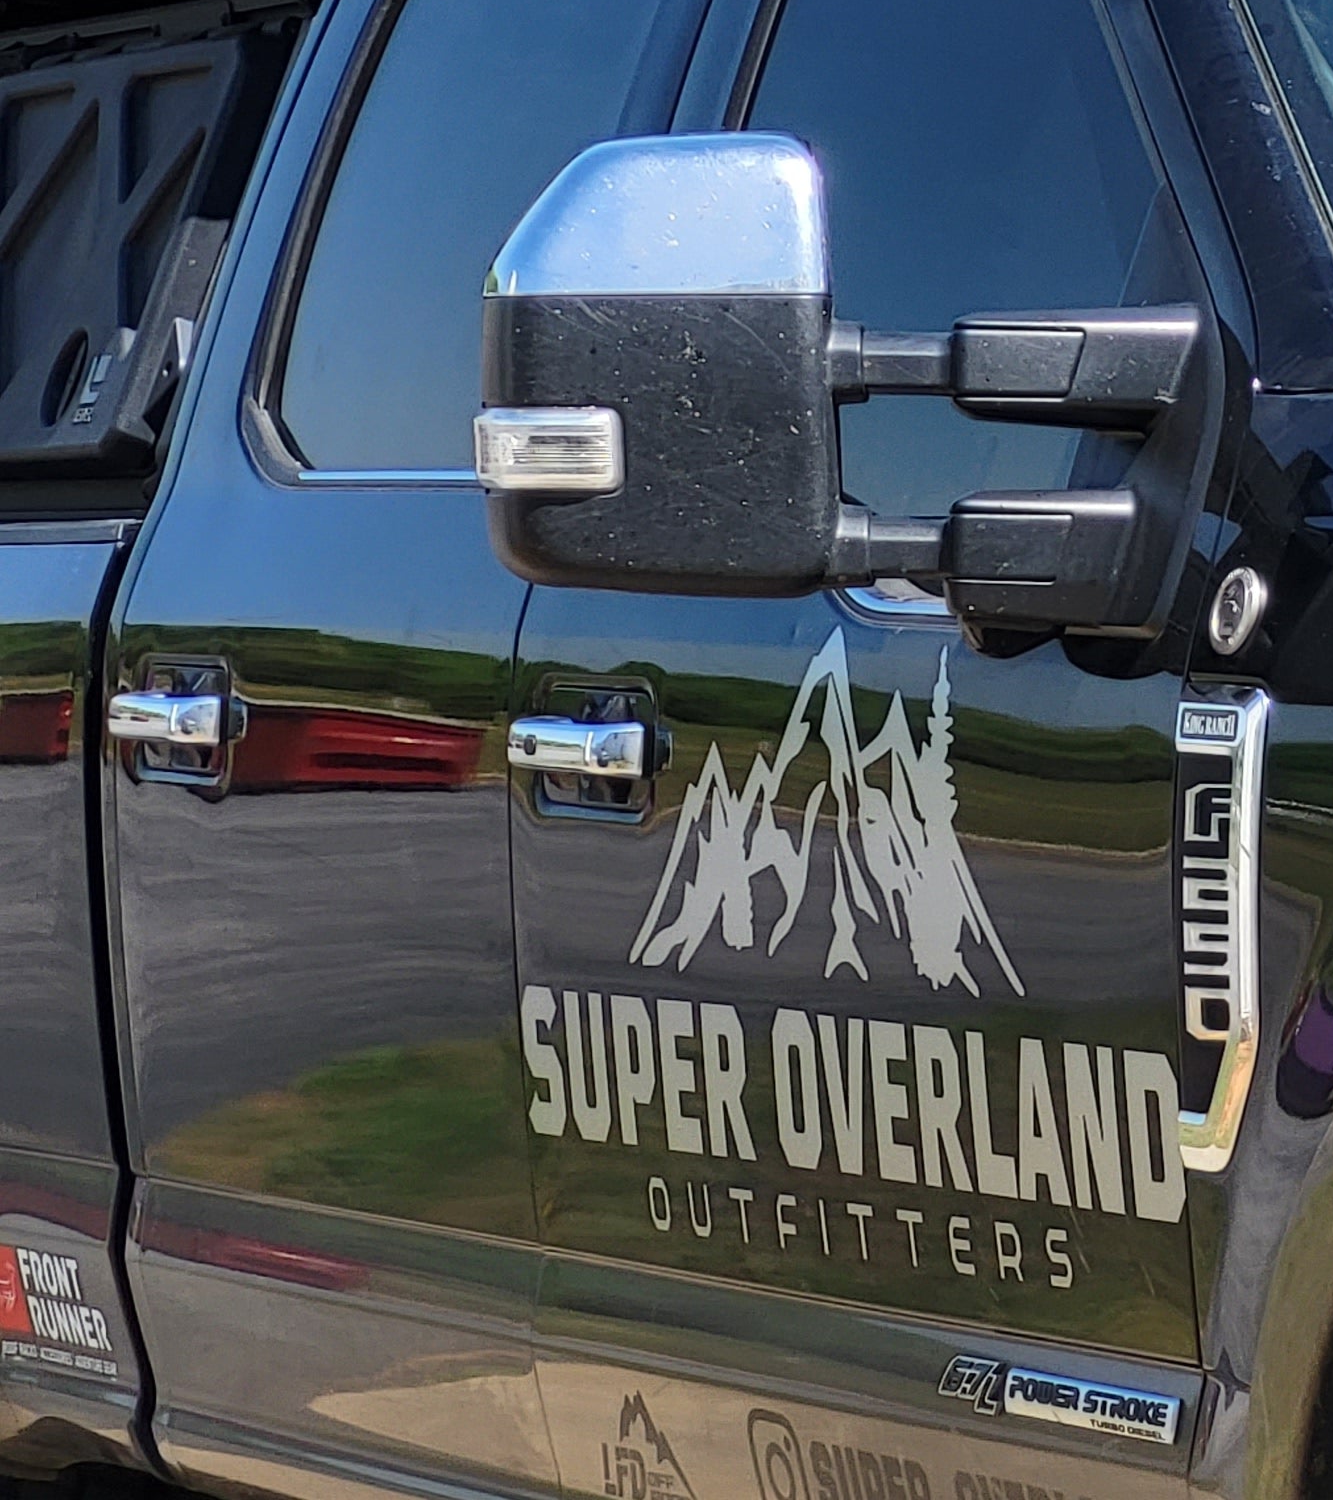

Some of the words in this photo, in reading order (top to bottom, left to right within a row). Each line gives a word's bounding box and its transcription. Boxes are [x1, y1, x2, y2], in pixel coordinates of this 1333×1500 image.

[1183, 712, 1206, 735] KING
[520, 984, 757, 1162] SUPER
[771, 1006, 1187, 1224] OVERLAND
[648, 1176, 1073, 1289] OUTFITTERS
[16, 1247, 82, 1301] FRONT
[26, 1294, 114, 1352] RUNNER
[1008, 1375, 1080, 1411] POWER
[1082, 1389, 1169, 1428] STROKE
[1089, 1419, 1126, 1433] TURBO
[601, 1442, 647, 1500] LFD
